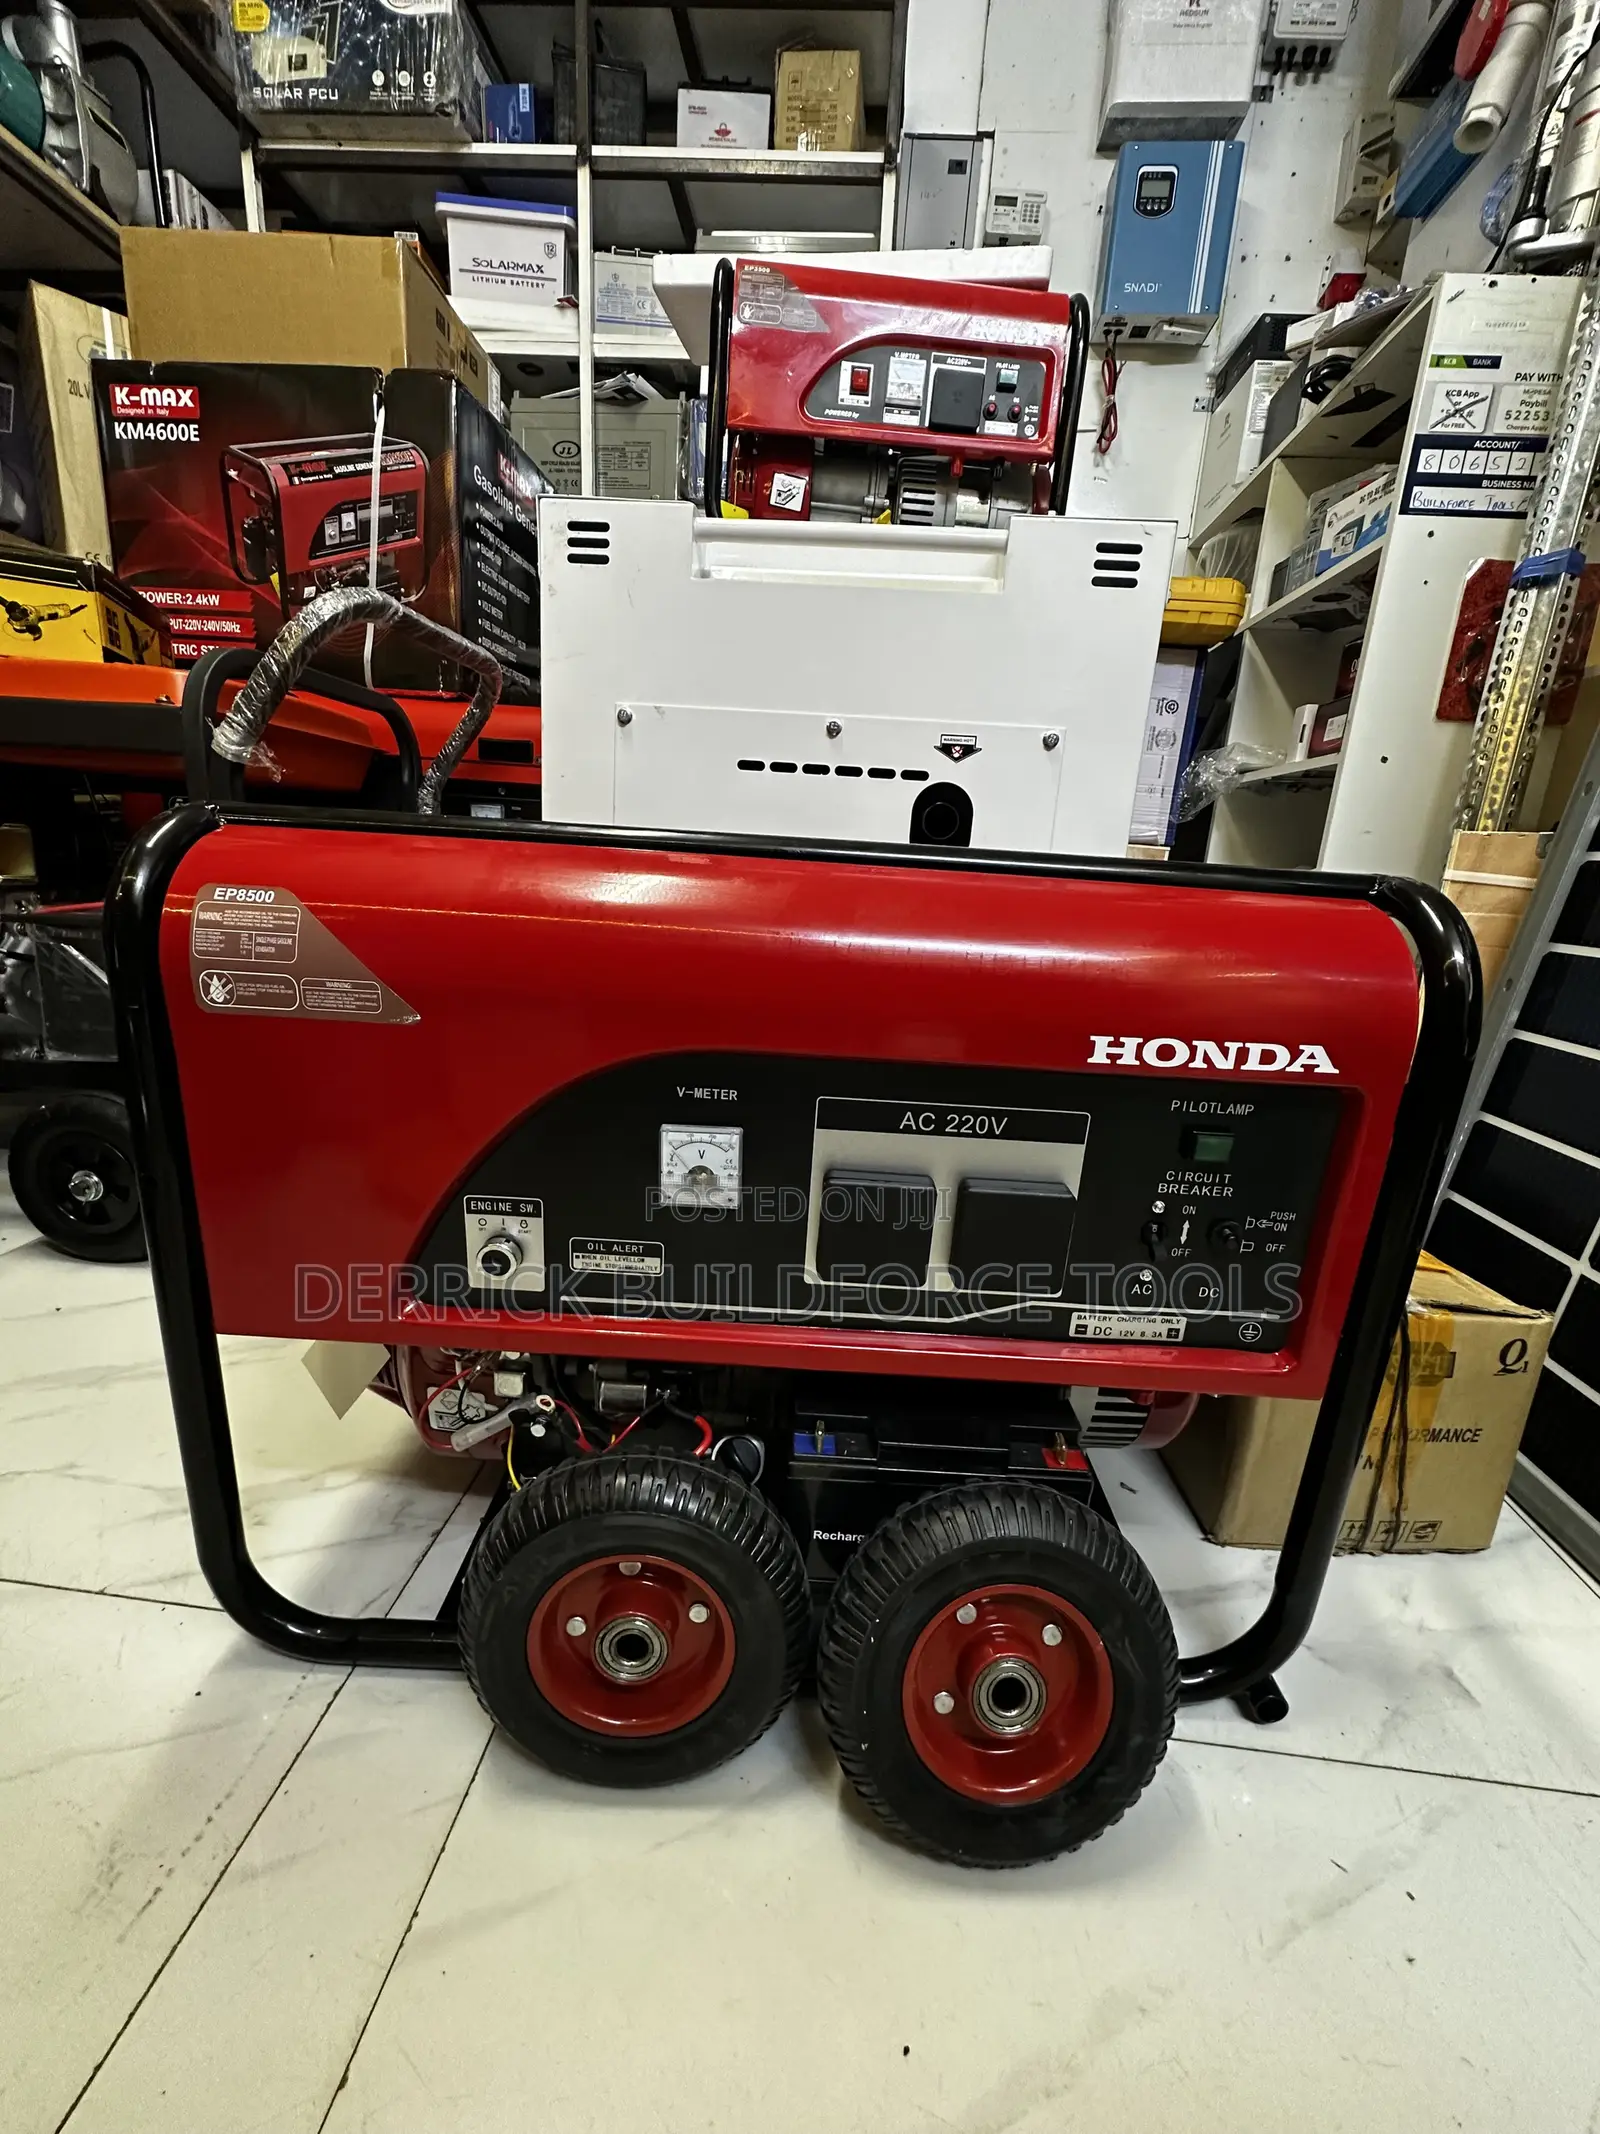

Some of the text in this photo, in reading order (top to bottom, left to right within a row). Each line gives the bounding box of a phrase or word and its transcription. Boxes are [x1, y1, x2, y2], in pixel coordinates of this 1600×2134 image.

[253, 87, 339, 100] SOLAR PCU
[546, 244, 554, 252] 12
[472, 257, 545, 274] SOLARMAX
[472, 275, 546, 289] LITHIUM BATTERY
[1123, 283, 1159, 293] SNADI
[1472, 358, 1492, 366] BANK
[1514, 372, 1536, 382] PAY
[114, 386, 195, 408] K-MAX
[1445, 389, 1480, 399] KCB App
[1520, 400, 1548, 409] Paybill
[116, 406, 145, 415] Designed
[156, 408, 170, 417] Italy
[114, 421, 200, 442] KM4600E
[559, 446, 573, 455] JL
[1481, 480, 1522, 488] BUSINESS
[473, 464, 514, 516] Gasoline
[213, 887, 275, 903] EP8500
[1086, 1035, 1340, 1074] HONDA
[676, 1086, 738, 1101] V-METER
[1170, 1099, 1255, 1116] PILOTLAMP
[900, 1111, 1008, 1135] AC 220V
[698, 1149, 706, 1160] V
[1166, 1170, 1232, 1185] CIRCUIT
[1157, 1183, 1234, 1198] BREAKER
[470, 1200, 513, 1212] ENGINE
[1182, 1204, 1197, 1215] ON
[1270, 1211, 1297, 1221] PUSH
[1274, 1222, 1288, 1232] ON
[587, 1242, 644, 1254] OIL ALERT
[1171, 1247, 1193, 1258] OFF
[1265, 1243, 1287, 1253] OFF
[581, 1253, 598, 1261] WHEN
[1131, 1284, 1153, 1295] AC
[1198, 1286, 1220, 1299] DC
[1076, 1314, 1113, 1322] BATTERY
[1116, 1316, 1157, 1324] CHARGING
[1092, 1326, 1113, 1337] DC
[1119, 1330, 1135, 1338] 12V
